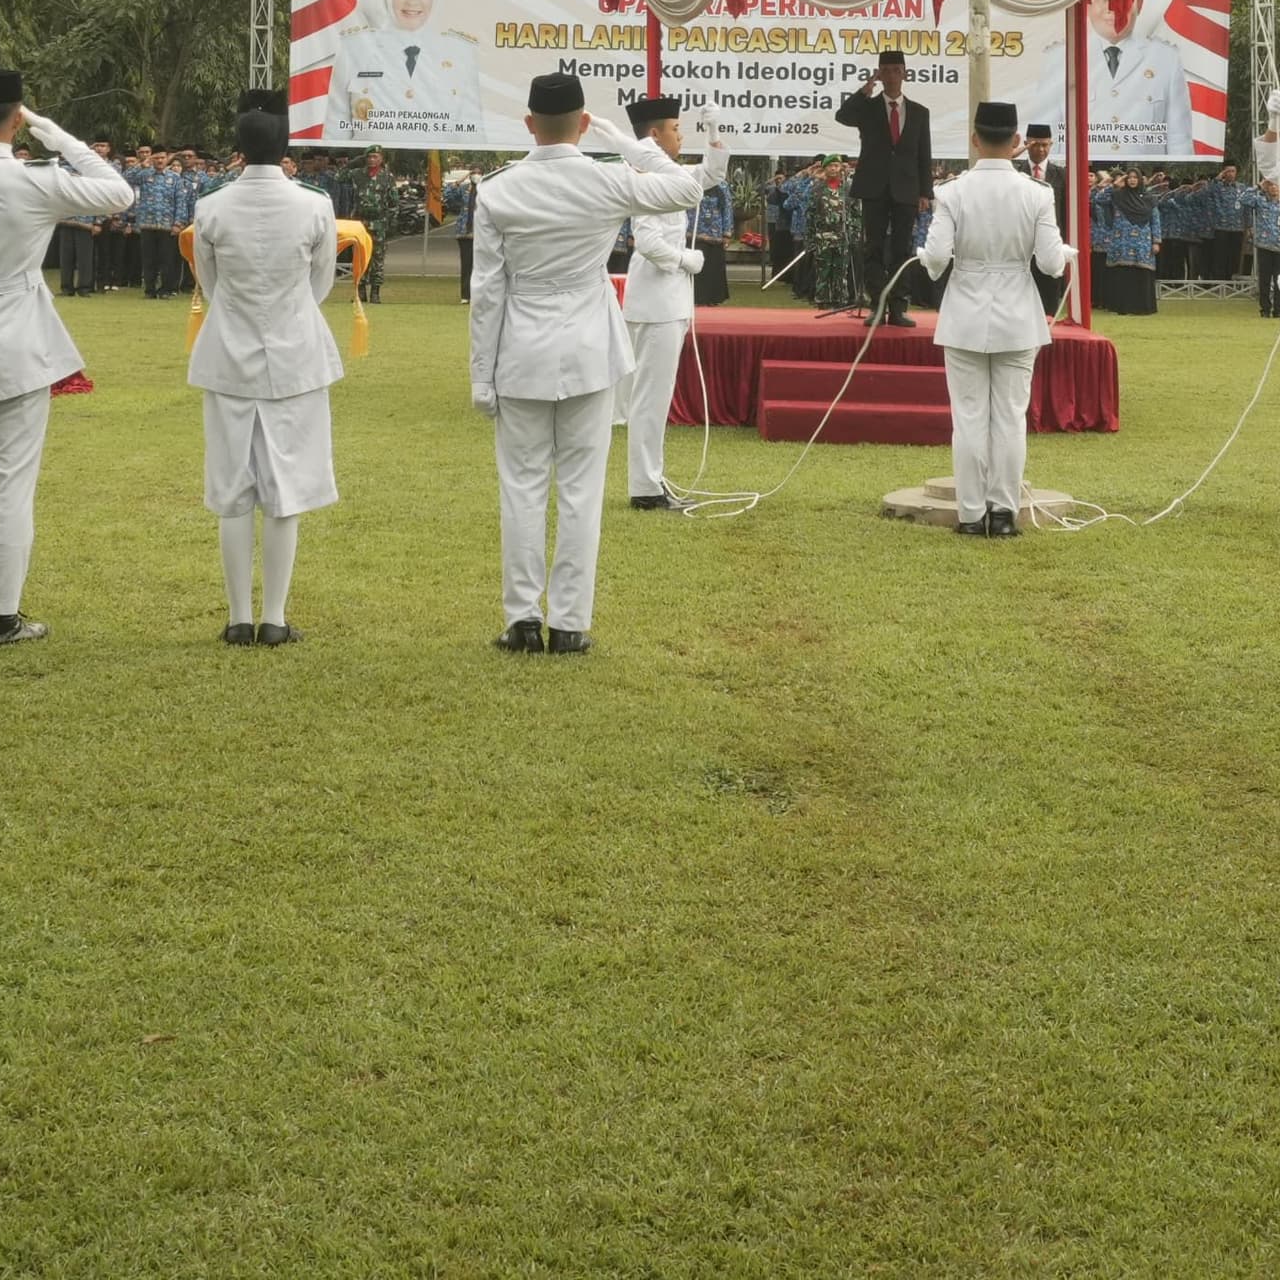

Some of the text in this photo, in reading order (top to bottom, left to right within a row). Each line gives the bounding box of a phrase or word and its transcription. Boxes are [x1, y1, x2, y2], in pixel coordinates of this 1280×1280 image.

[495, 23, 568, 49] HARI
[669, 26, 837, 55] PANCASILA
[839, 29, 941, 56] TAHUN
[945, 30, 1024, 57] 225
[559, 58, 959, 86] Mempekokoh Ideologi Paasila
[714, 89, 833, 110] Indonesia
[368, 110, 450, 120] BUPATI PEKALONGAN
[353, 121, 366, 132] Hj.
[368, 122, 394, 131] FADIA
[455, 124, 478, 133] M.M.
[696, 122, 819, 135] Ken, 2 Juni 2025
[1114, 124, 1167, 132] PEKALONGAN
[1146, 136, 1166, 144] M.S.
